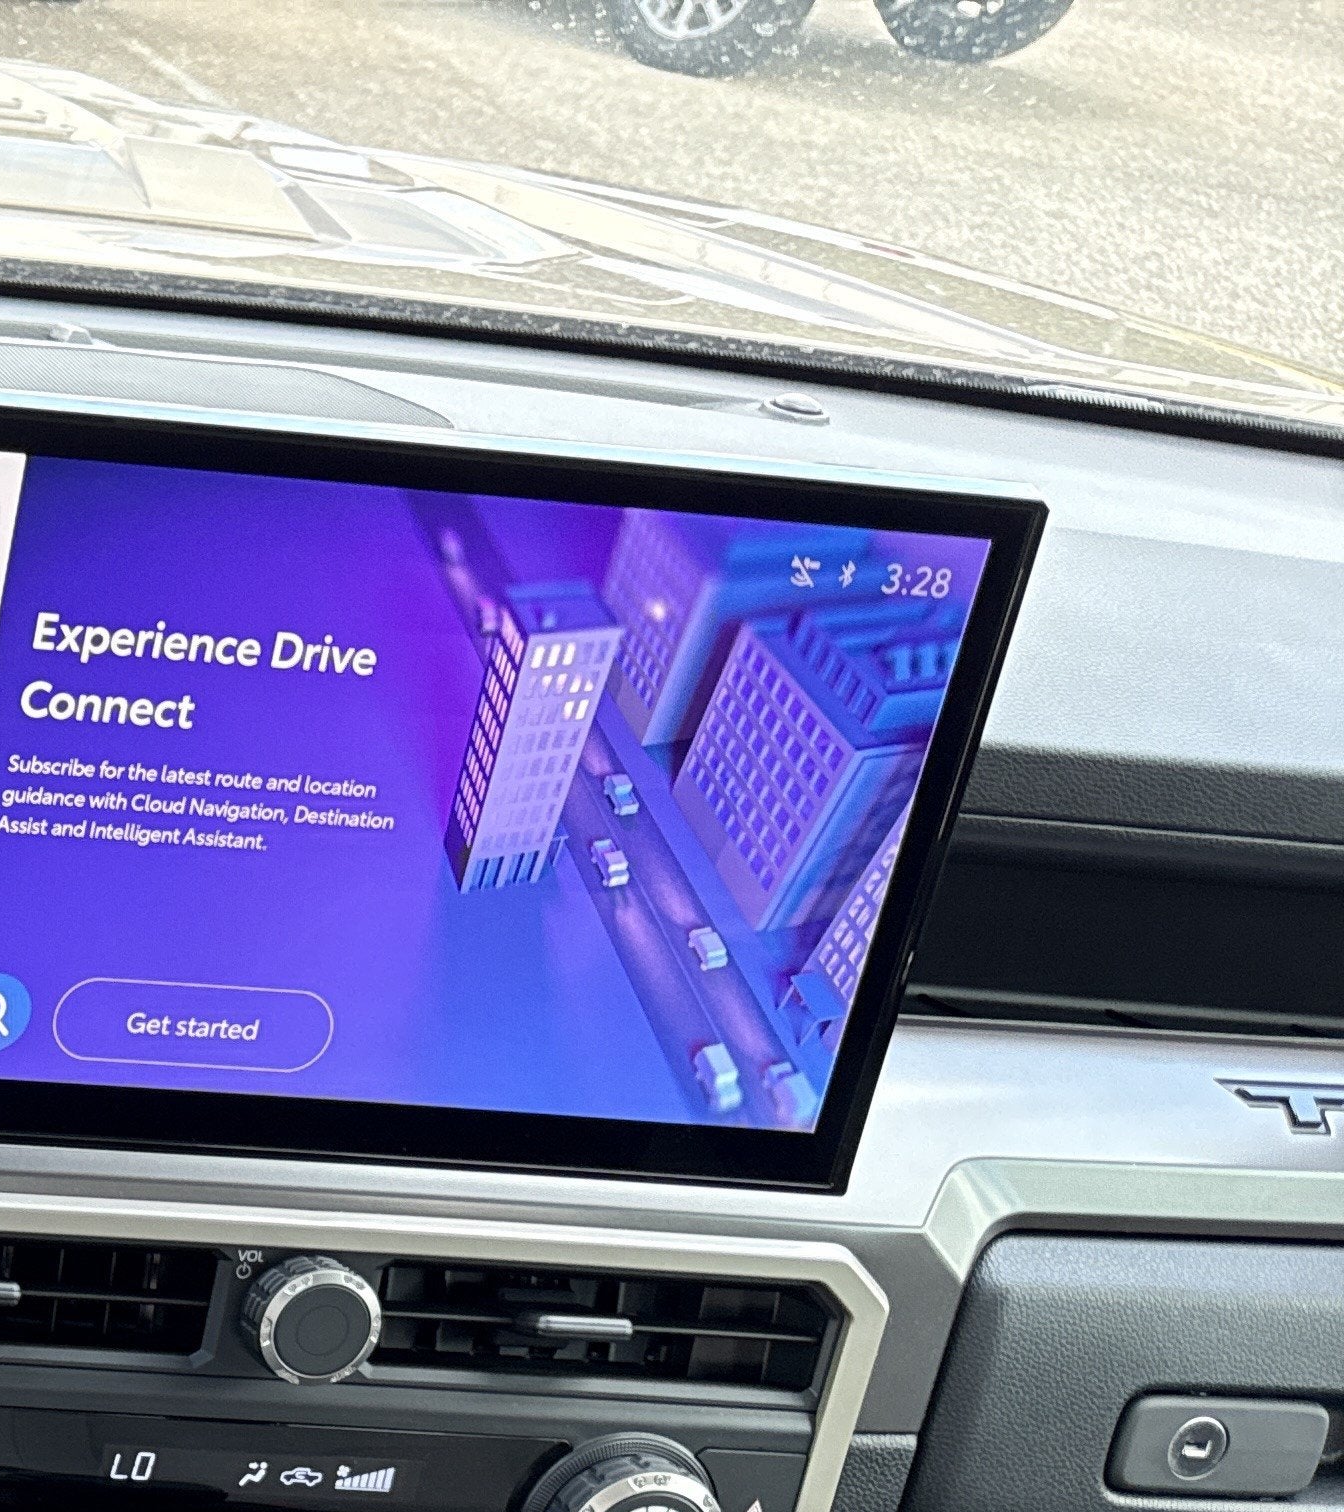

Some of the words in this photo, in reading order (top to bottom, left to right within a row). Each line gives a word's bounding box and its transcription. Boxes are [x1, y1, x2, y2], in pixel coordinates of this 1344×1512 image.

[880, 563, 953, 599] 3:28
[32, 611, 263, 668] Experience
[271, 631, 378, 677] Drive
[20, 680, 195, 730] Connect
[8, 754, 95, 780] Subscribe
[99, 760, 125, 780] for
[128, 763, 158, 783] the
[161, 765, 211, 787] latest
[214, 771, 262, 791] route
[265, 771, 300, 793] and
[304, 774, 377, 799] location
[2, 786, 86, 809] guidance
[89, 790, 127, 812] with
[131, 793, 185, 815] Cloud
[189, 797, 289, 826] Navigation,
[293, 805, 395, 831] Destination
[51, 819, 86, 838] and
[90, 821, 179, 846] Intelligent
[183, 829, 267, 852] Assistant.
[127, 1012, 170, 1036] Get
[175, 1016, 260, 1041] started
[238, 1250, 264, 1262] VOL
[110, 1451, 155, 1481] LO
